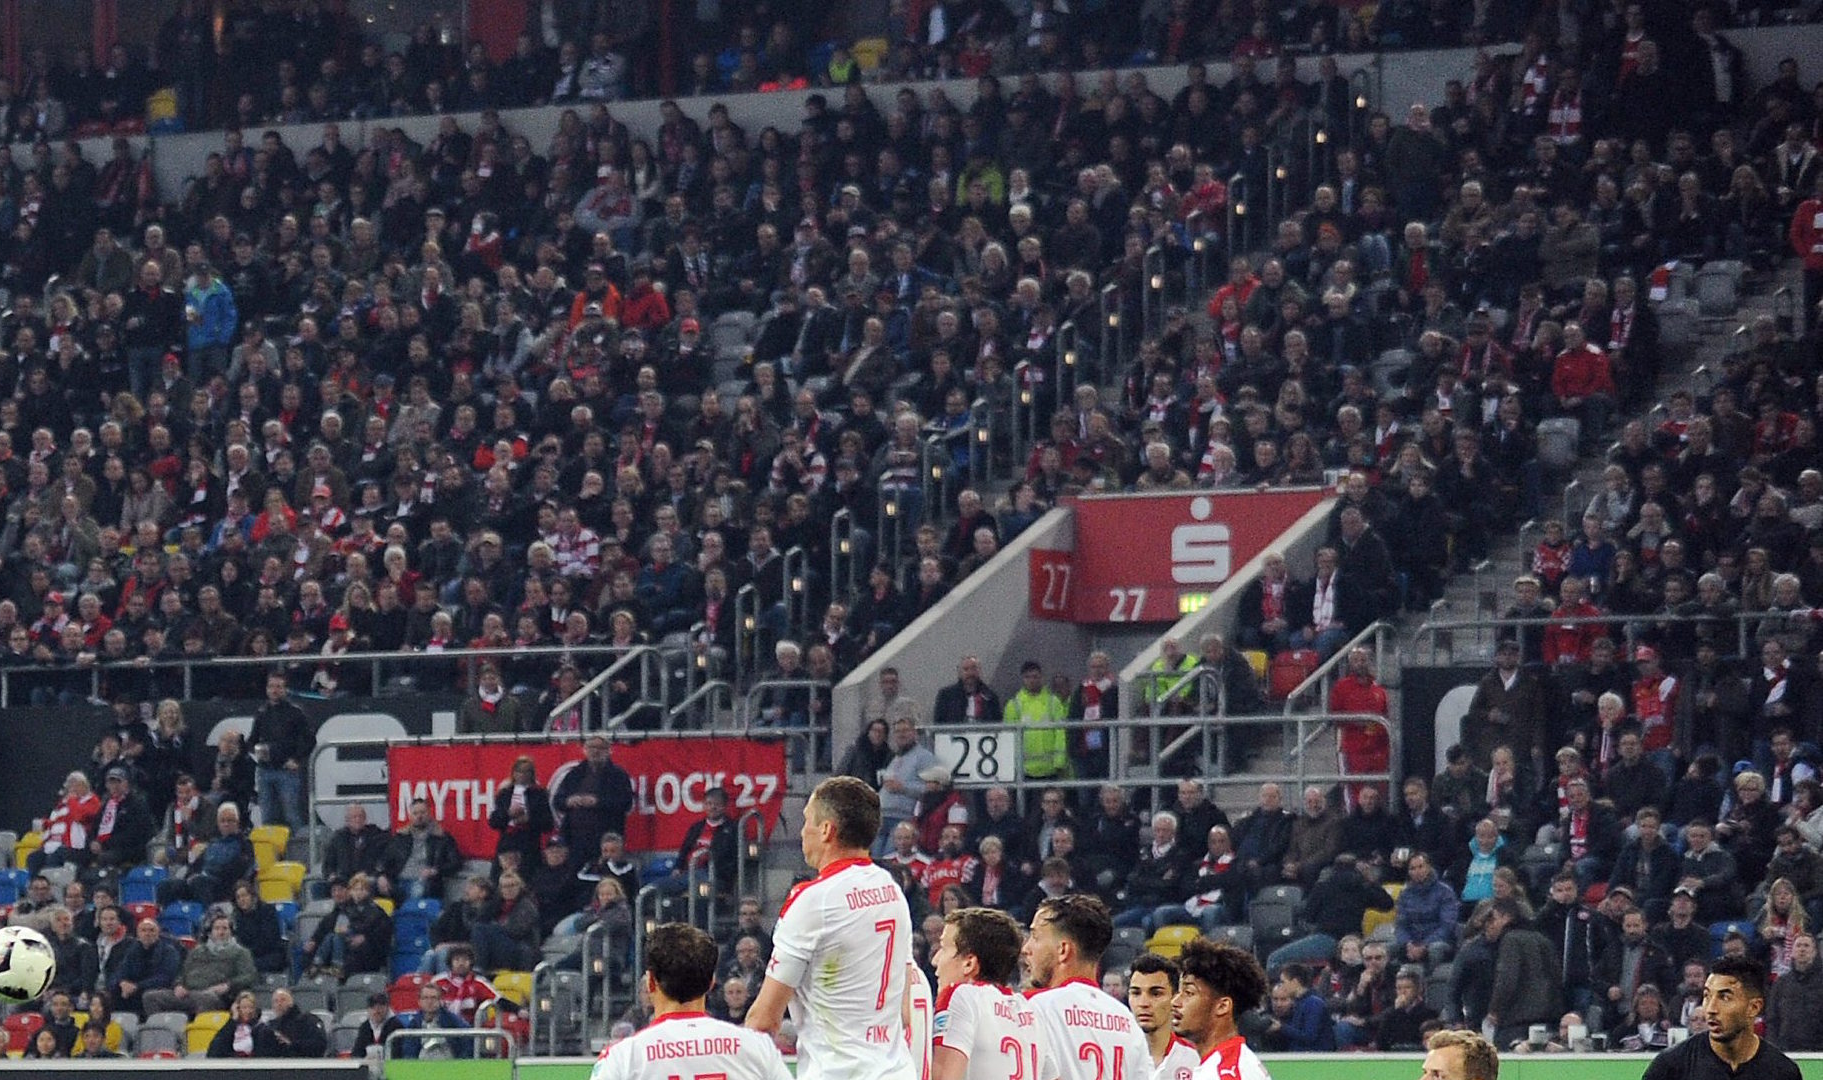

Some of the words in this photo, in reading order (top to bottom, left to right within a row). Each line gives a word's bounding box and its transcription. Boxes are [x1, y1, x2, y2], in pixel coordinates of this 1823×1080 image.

[1041, 563, 1071, 611] 27
[1109, 588, 1147, 622] 27
[951, 735, 999, 778] 28
[733, 773, 777, 808] 27
[875, 918, 896, 1010] 7
[865, 1023, 891, 1044] FINK
[1064, 1005, 1131, 1033] DÜSSELDORF
[646, 1037, 741, 1062] DÜSSELDORF
